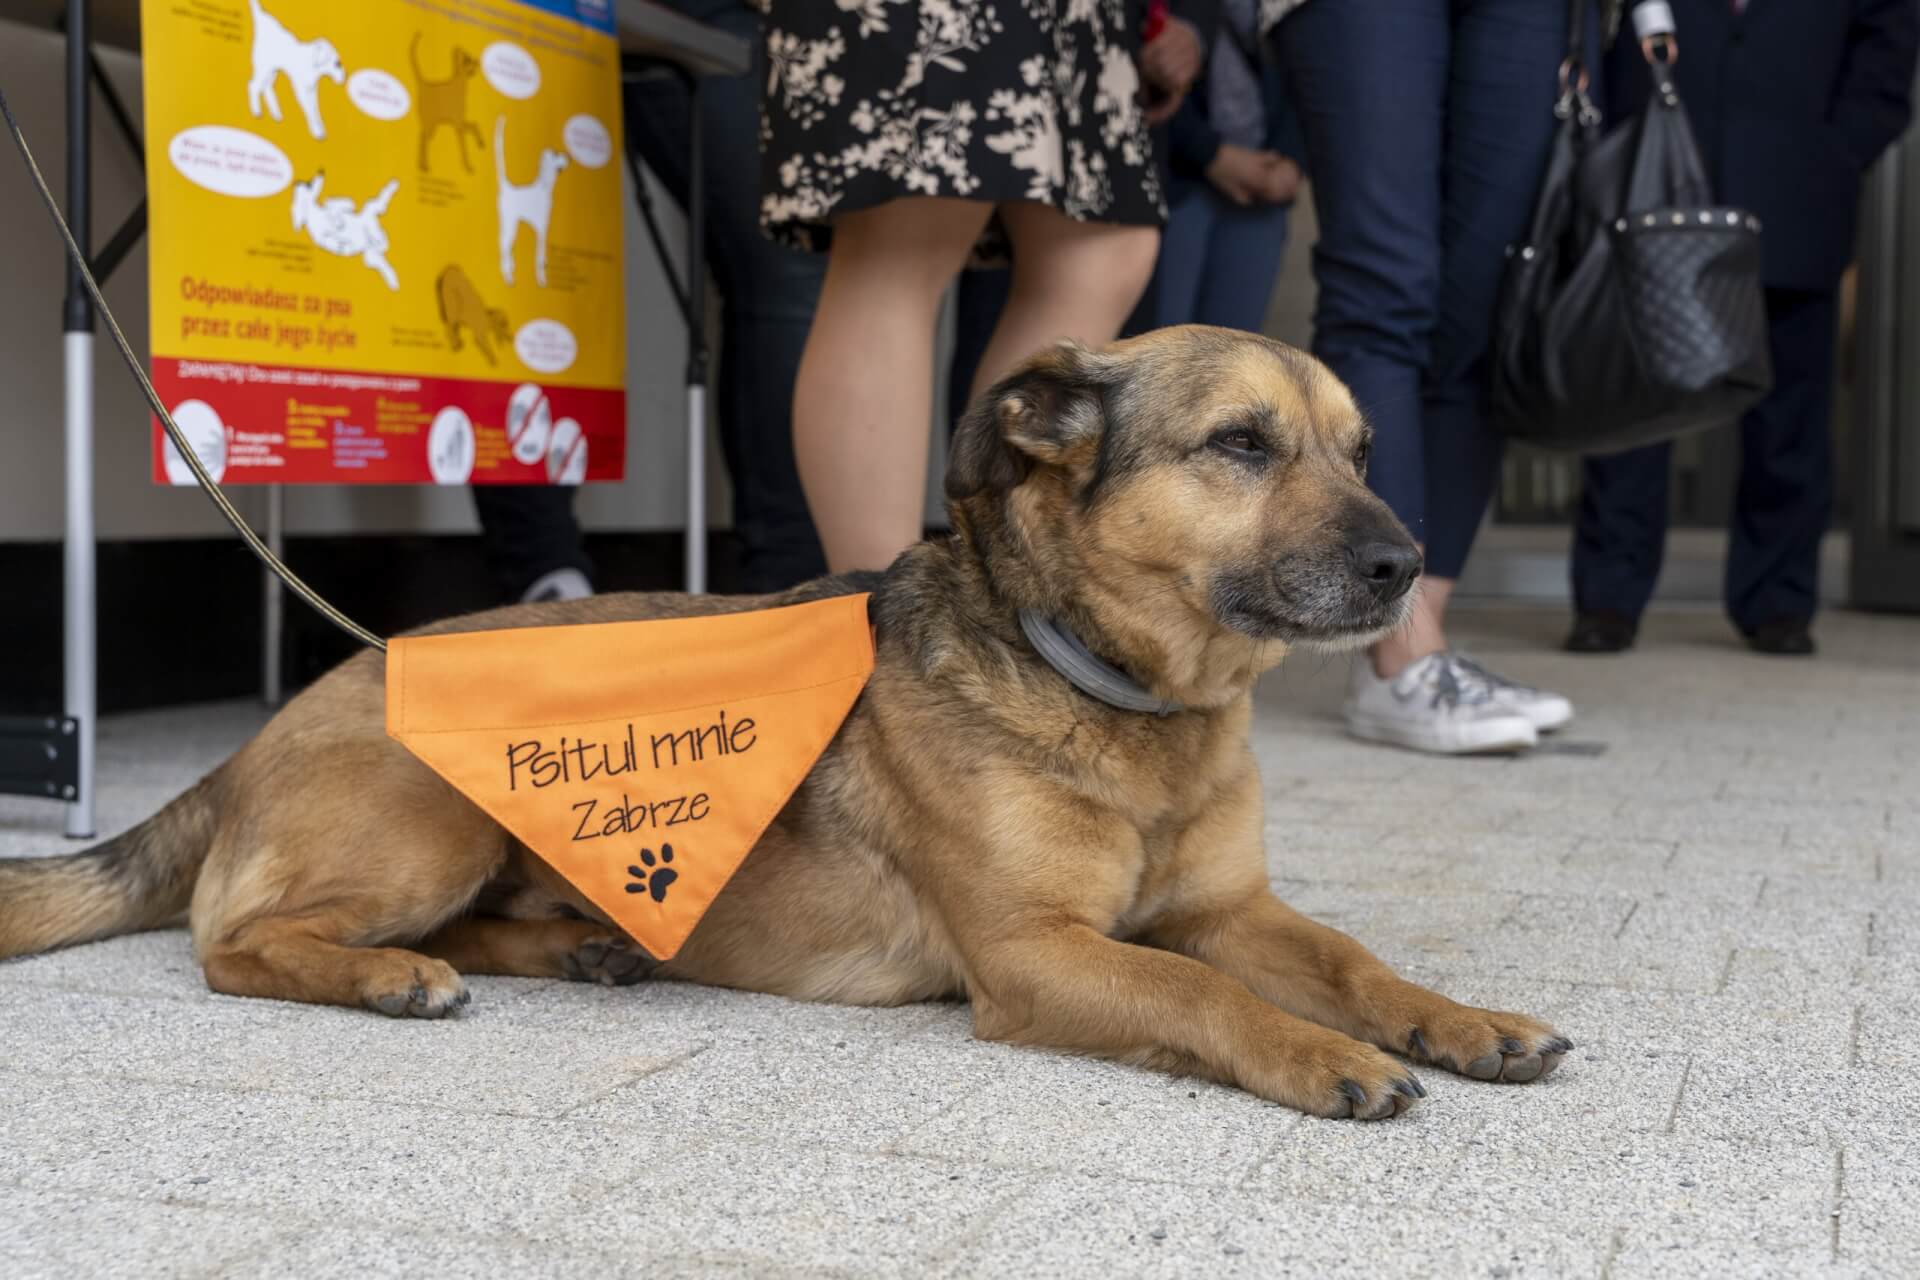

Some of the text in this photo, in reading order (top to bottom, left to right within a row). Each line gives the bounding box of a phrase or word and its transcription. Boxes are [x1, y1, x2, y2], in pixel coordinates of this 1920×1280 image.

[181, 276, 352, 319] Odpowiadasz za psa
[181, 316, 230, 341] przez
[276, 320, 311, 350] jego
[506, 710, 757, 791] Psitul mnie
[571, 793, 710, 841] Zabrze
